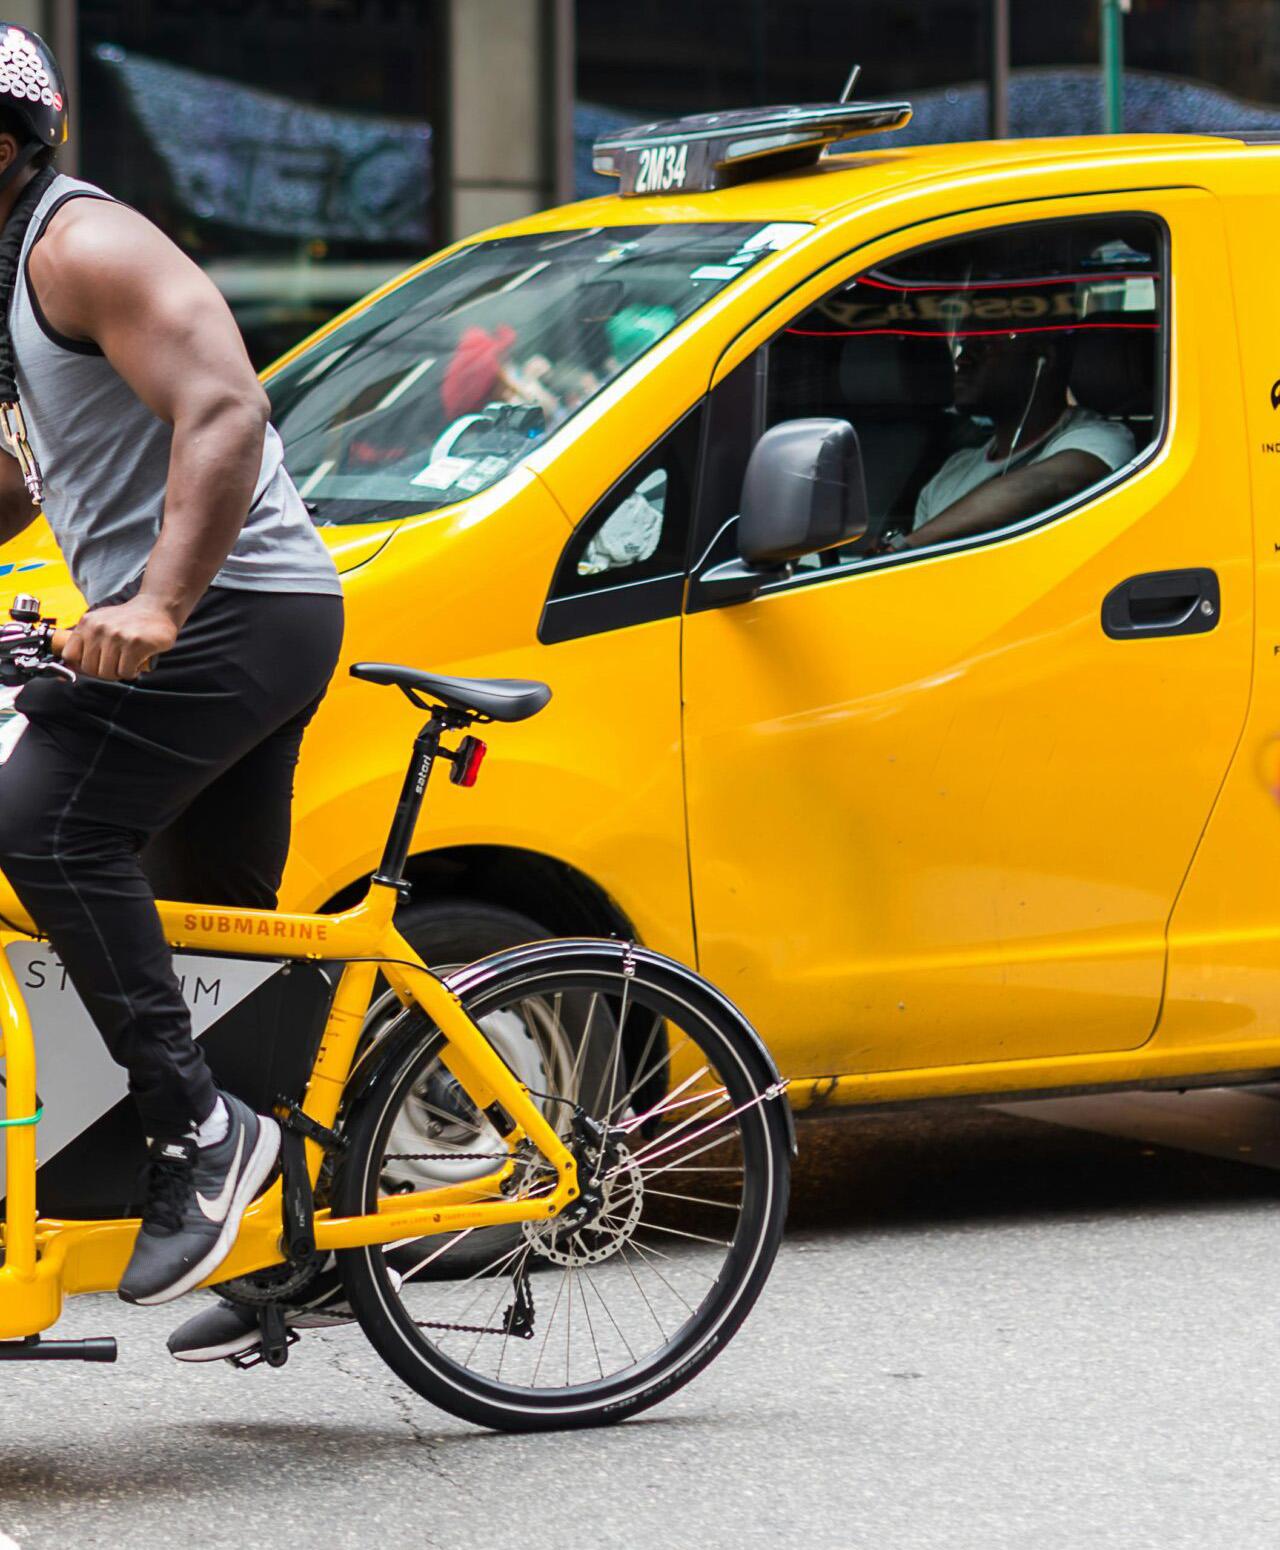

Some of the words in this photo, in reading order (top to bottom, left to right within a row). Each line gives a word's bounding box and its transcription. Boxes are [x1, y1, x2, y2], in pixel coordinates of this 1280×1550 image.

[636, 144, 688, 192] 2M34
[416, 754, 431, 795] satori
[183, 914, 327, 940] SUBMARINE
